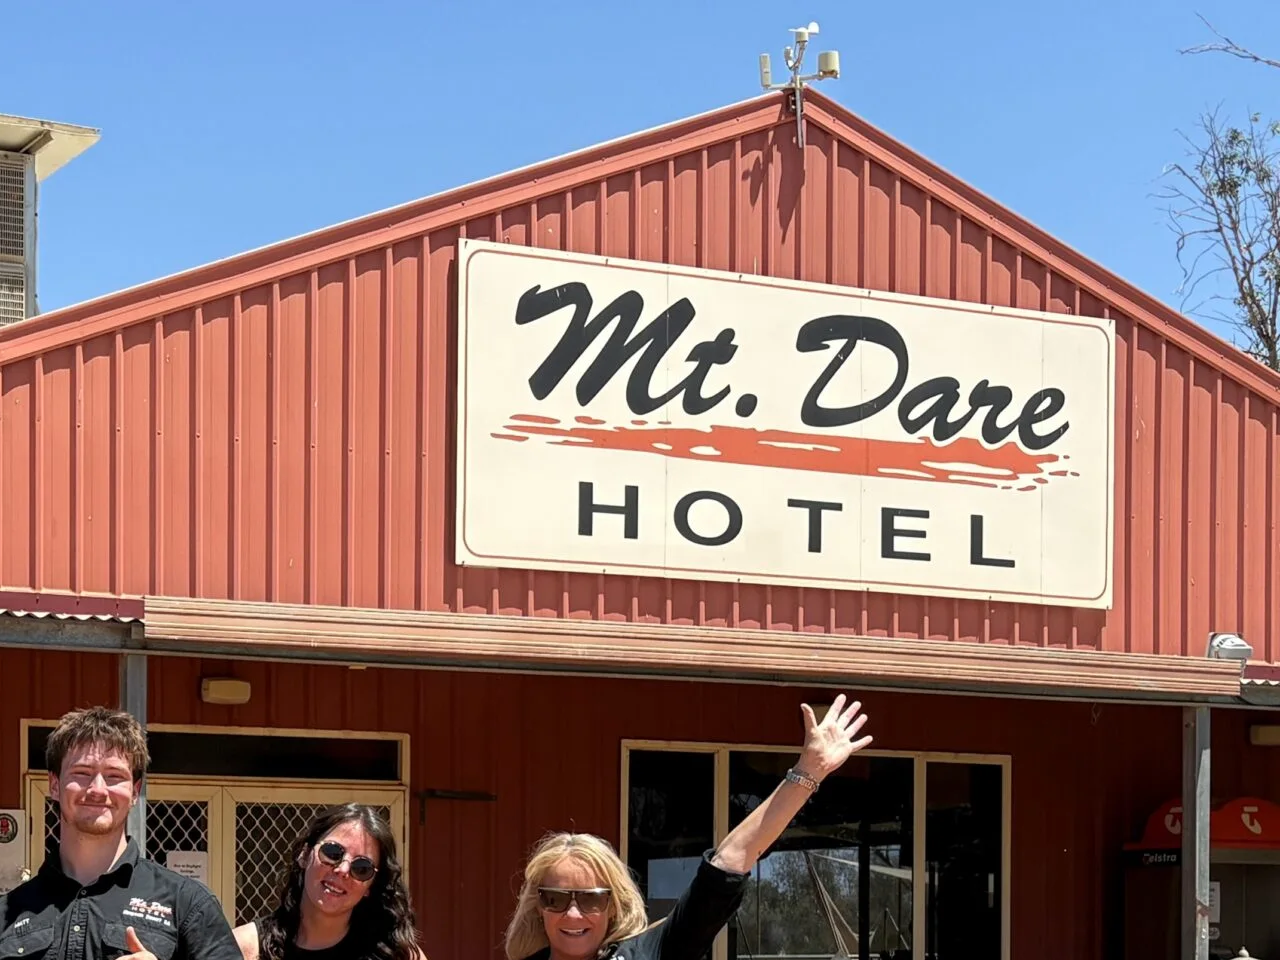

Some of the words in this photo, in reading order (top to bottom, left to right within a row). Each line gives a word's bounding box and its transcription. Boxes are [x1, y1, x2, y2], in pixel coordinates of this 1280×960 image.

[516, 283, 757, 417] Mt.
[797, 315, 1069, 449] Dare
[579, 482, 1014, 567] HOTEL
